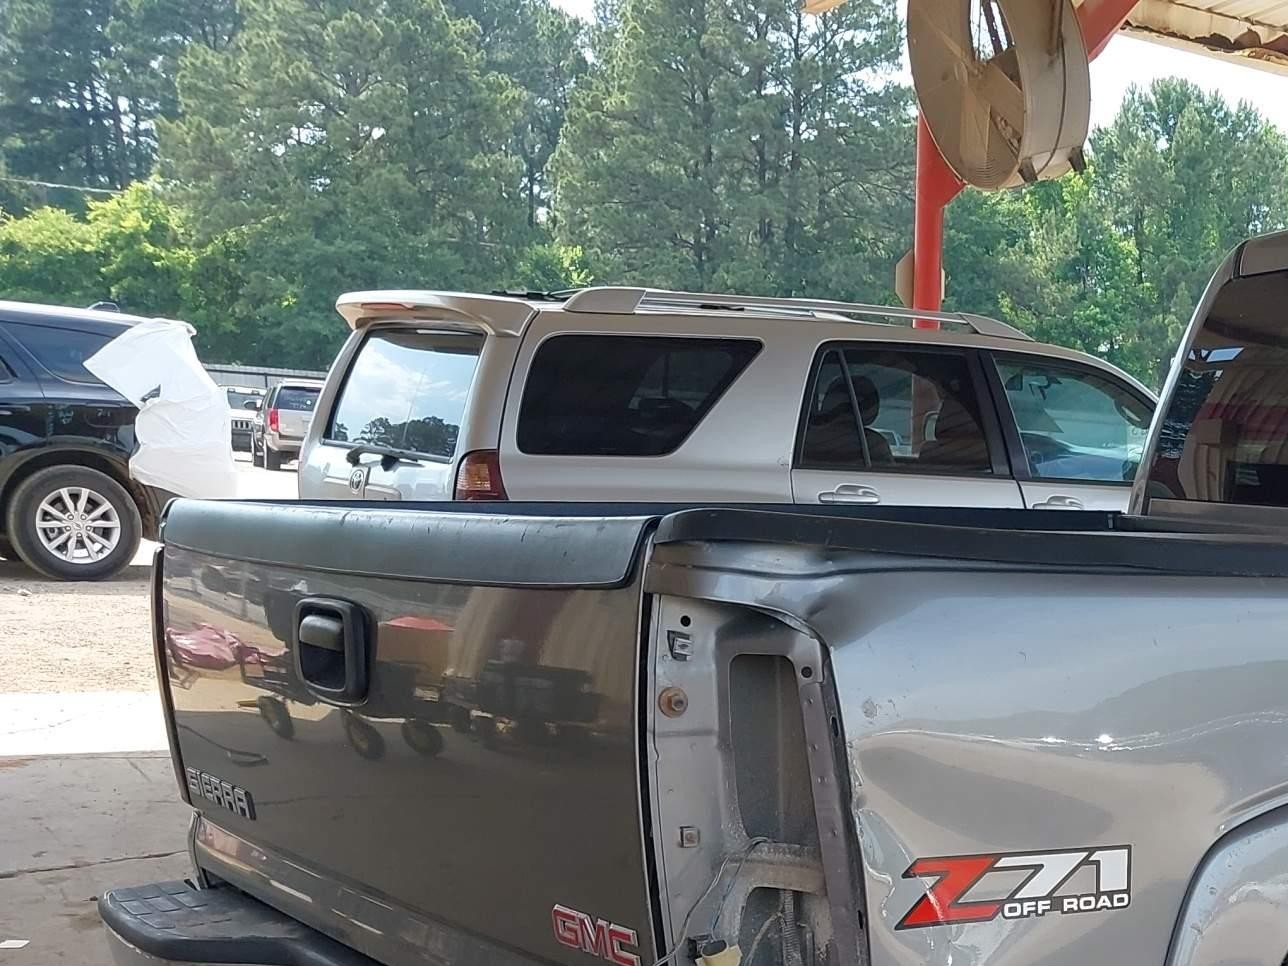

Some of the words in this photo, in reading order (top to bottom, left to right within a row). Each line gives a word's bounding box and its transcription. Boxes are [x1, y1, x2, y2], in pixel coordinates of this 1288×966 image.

[186, 767, 256, 820] SIERRA
[896, 846, 1132, 930] Z71
[1003, 900, 1051, 918] OFF
[1062, 893, 1130, 912] ROAD
